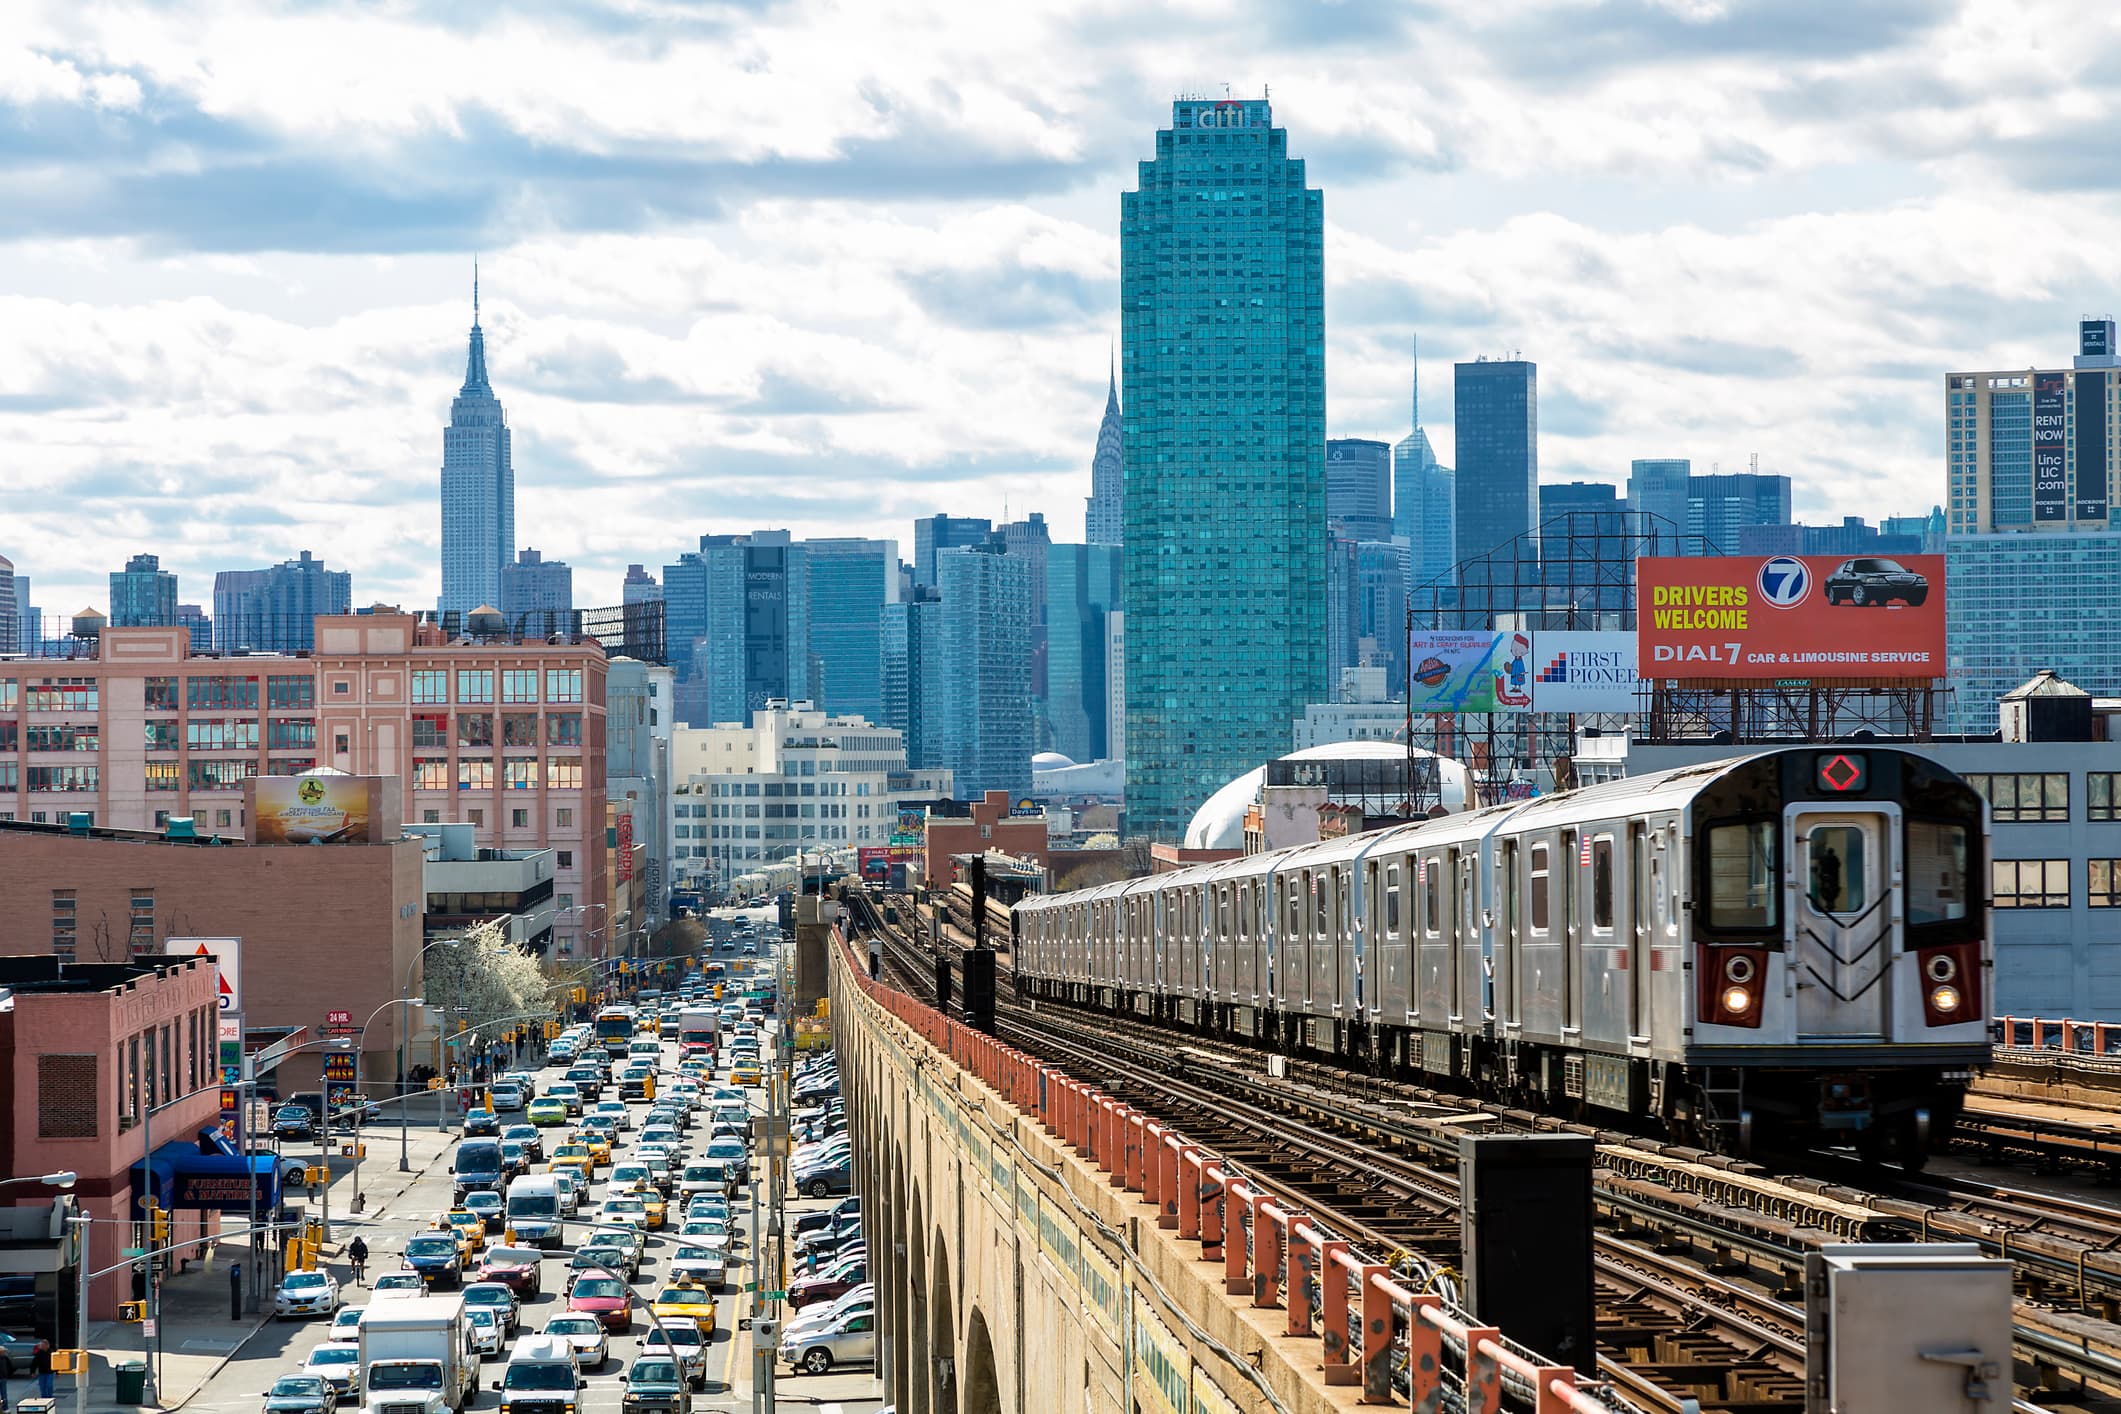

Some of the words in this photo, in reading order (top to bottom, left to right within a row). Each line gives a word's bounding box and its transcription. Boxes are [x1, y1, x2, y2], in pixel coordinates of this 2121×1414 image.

[1199, 104, 1243, 128] citi
[2036, 416, 2063, 426] RENT
[2036, 430, 2063, 440] NOW
[2038, 454, 2061, 465] Linc
[2041, 467, 2058, 478] LIC
[2035, 481, 2064, 490] .com
[1768, 564, 1801, 601] 7
[748, 591, 783, 601] RENTALS
[1653, 586, 1748, 606] DRIVERS
[1653, 610, 1748, 629] WELCOME
[1570, 652, 1623, 667] FIRST
[1747, 653, 1775, 663] CAR
[1778, 653, 1790, 662] &
[1793, 652, 1868, 663] LIMOUSINE
[1871, 652, 1930, 662] SERVICE
[1570, 668, 1651, 684] PIONEE
[1012, 808, 1028, 816] Days
[329, 1013, 337, 1022] 24
[219, 1027, 238, 1035] ORE
[330, 1055, 351, 1067] CAR
[327, 1068, 354, 1080] WASH
